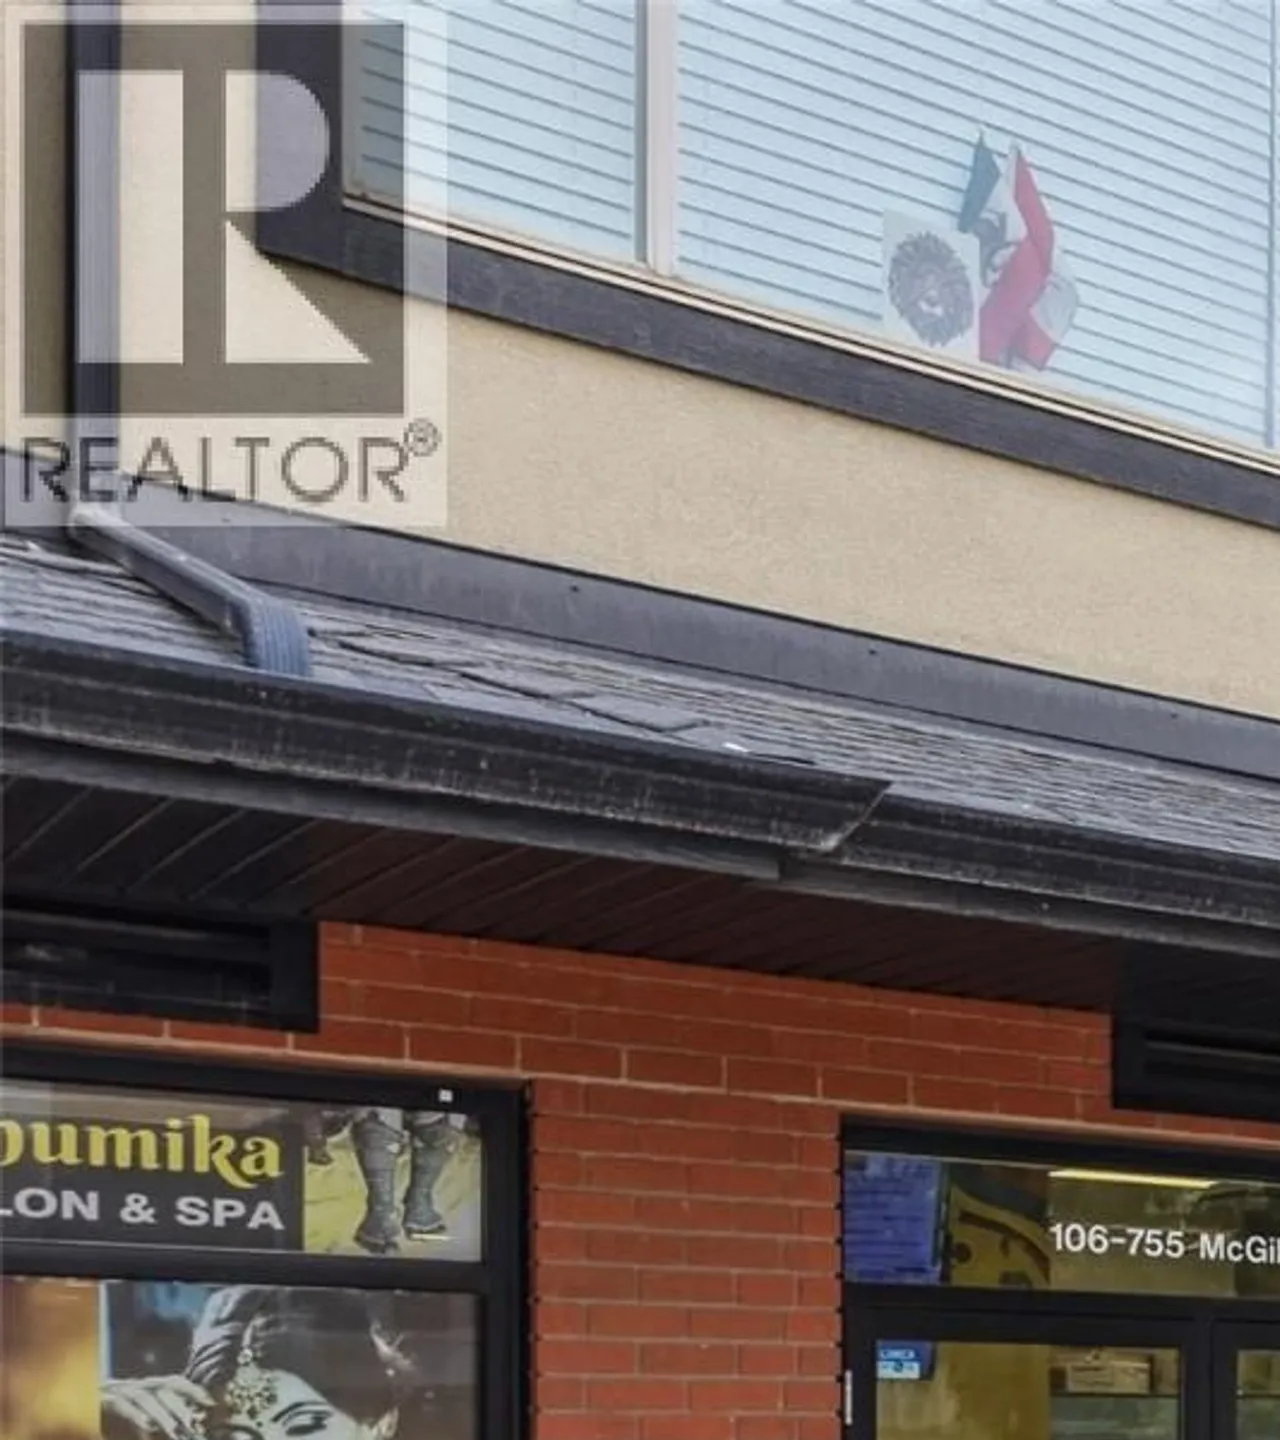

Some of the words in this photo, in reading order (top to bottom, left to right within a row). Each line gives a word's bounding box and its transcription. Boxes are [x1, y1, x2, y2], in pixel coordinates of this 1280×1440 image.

[119, 1193, 157, 1224] &
[174, 1196, 286, 1230] SPA
[1050, 1223, 1186, 1259] 106-755
